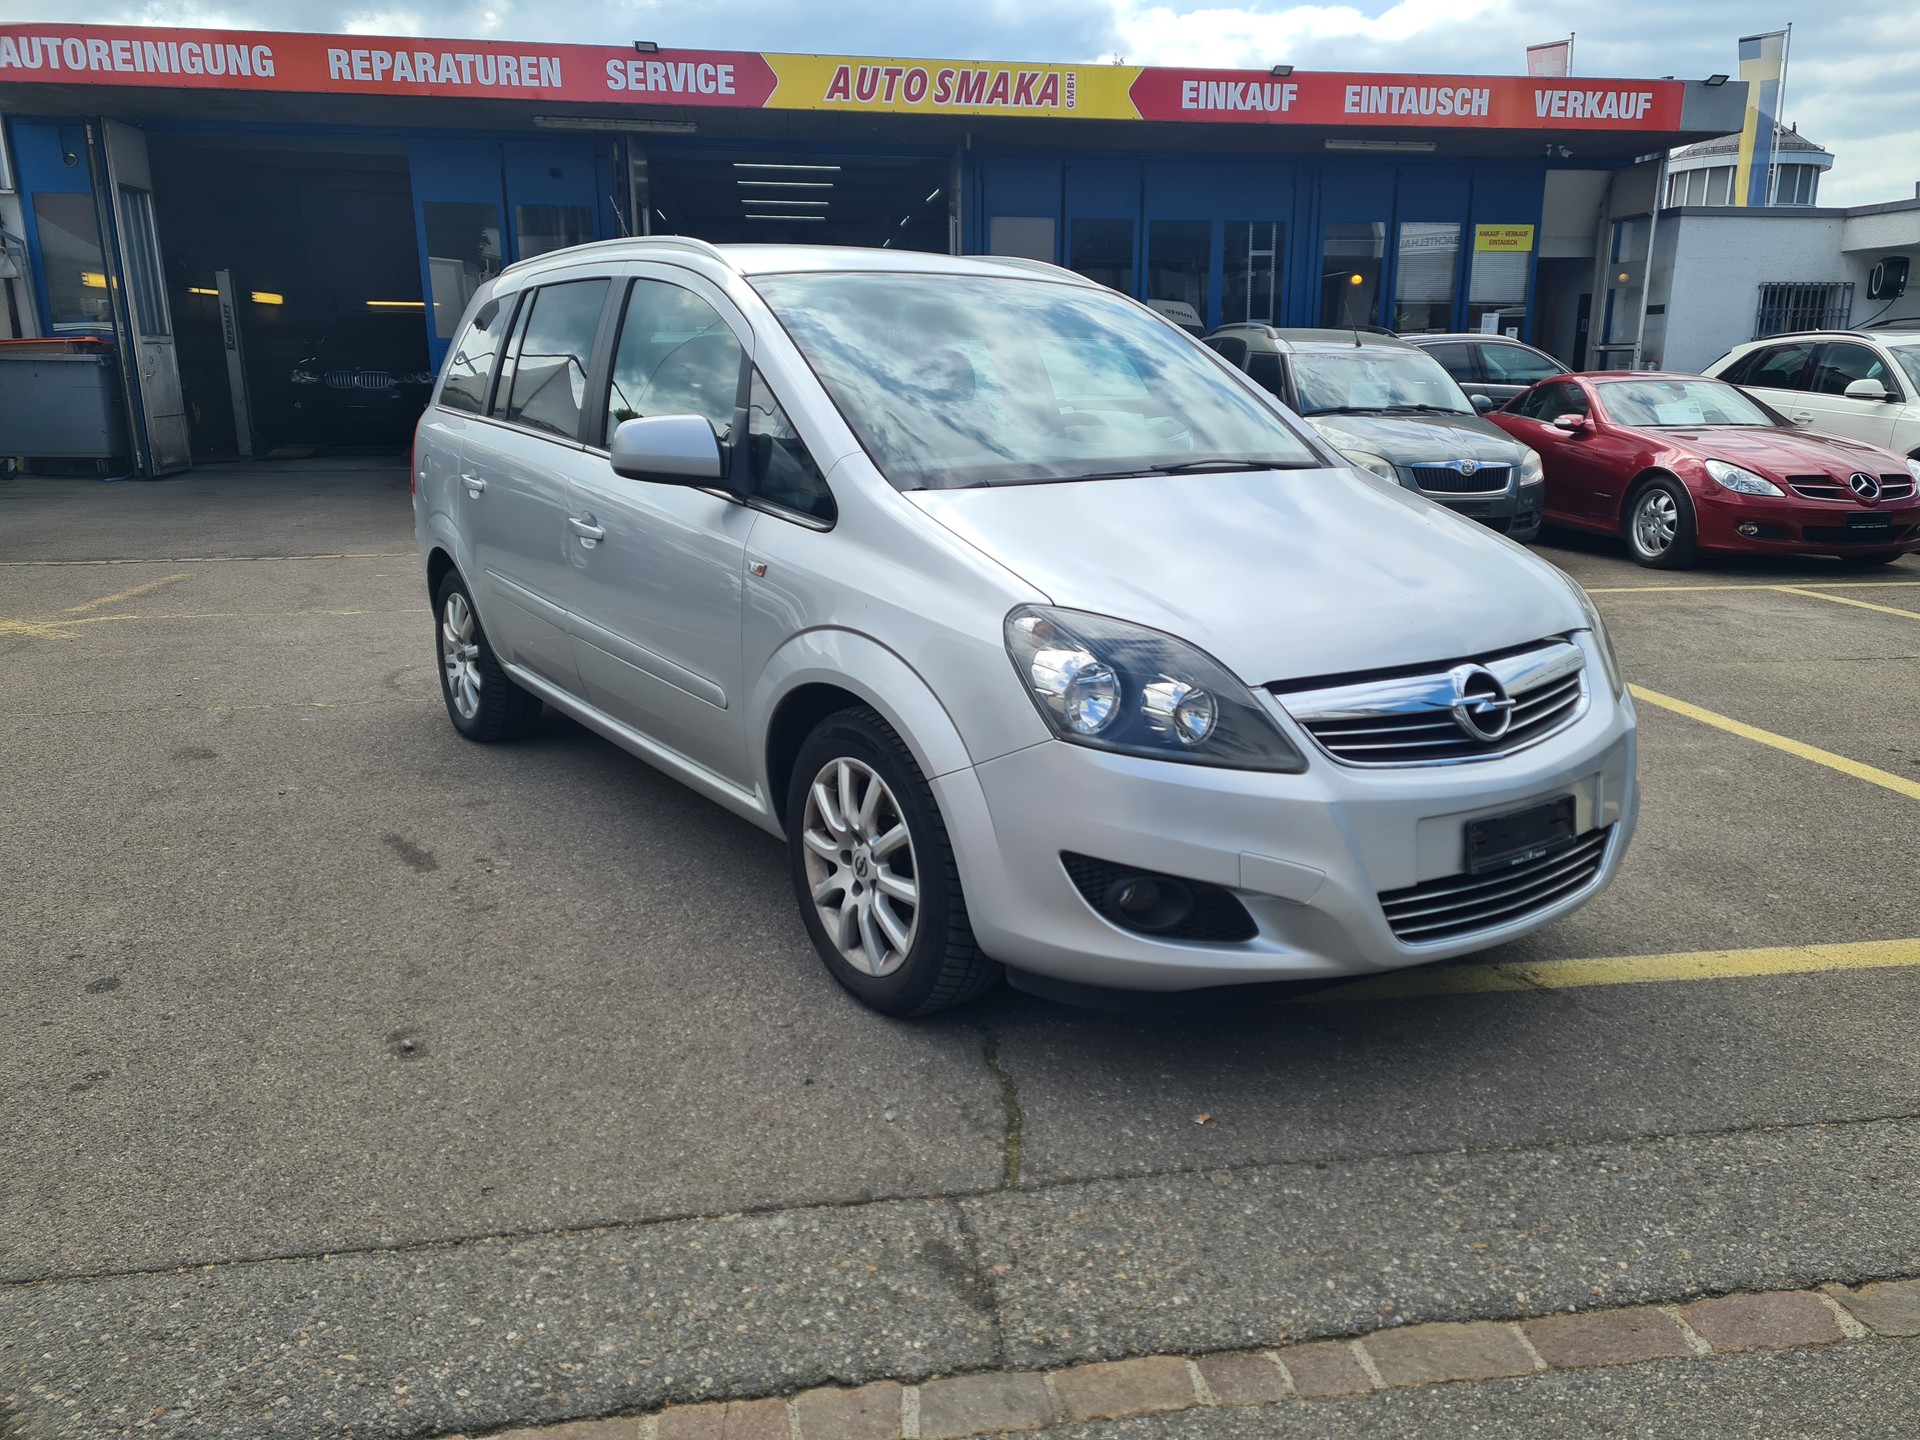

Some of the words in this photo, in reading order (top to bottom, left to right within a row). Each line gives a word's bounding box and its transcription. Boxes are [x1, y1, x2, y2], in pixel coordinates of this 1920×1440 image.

[0, 36, 275, 77] AUTOREINIGUNG
[327, 48, 562, 88] REPARATUREN
[605, 58, 736, 95] SERVICE
[823, 64, 929, 104] AUTO
[932, 67, 1061, 108] SMAKA
[1066, 72, 1076, 109] GMBH
[1181, 80, 1298, 112] EINKAUF
[1344, 85, 1490, 116] EINTAUSCH
[1534, 90, 1653, 120] VERKAUF
